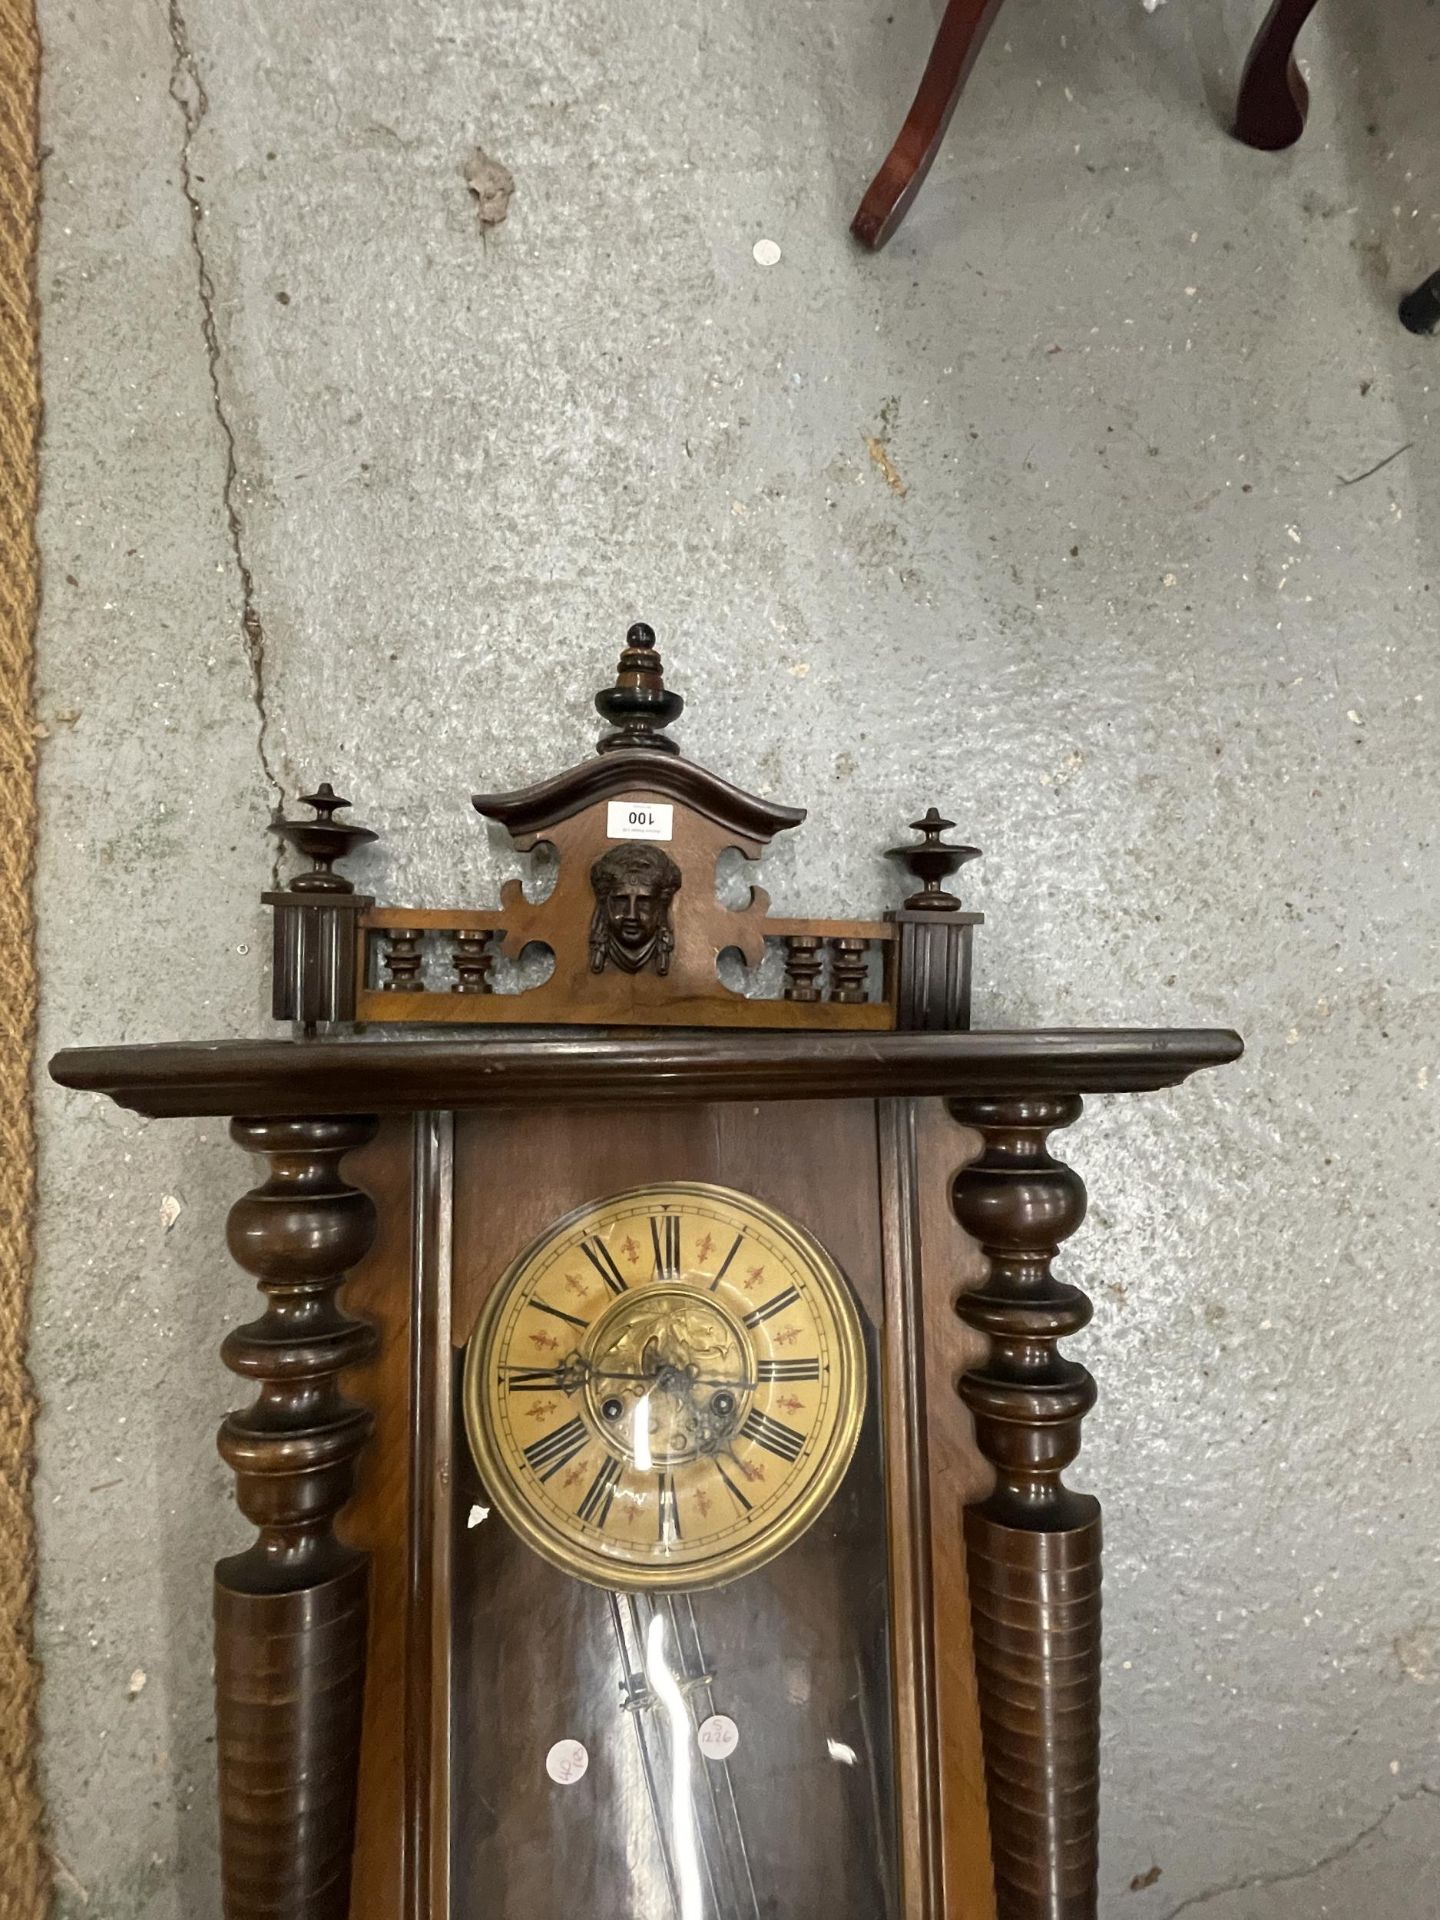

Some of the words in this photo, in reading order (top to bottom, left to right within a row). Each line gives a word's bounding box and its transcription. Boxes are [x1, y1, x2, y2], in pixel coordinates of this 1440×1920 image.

[629, 812, 655, 825] 100
[579, 1233, 629, 1299] XI
[650, 1215, 681, 1280] XII
[710, 1233, 744, 1291] I
[742, 1285, 802, 1329] II
[757, 1358, 819, 1382] III
[523, 1416, 591, 1484] VIII
[576, 1456, 624, 1528] VII
[658, 1473, 683, 1542] VI
[715, 1461, 754, 1518] V
